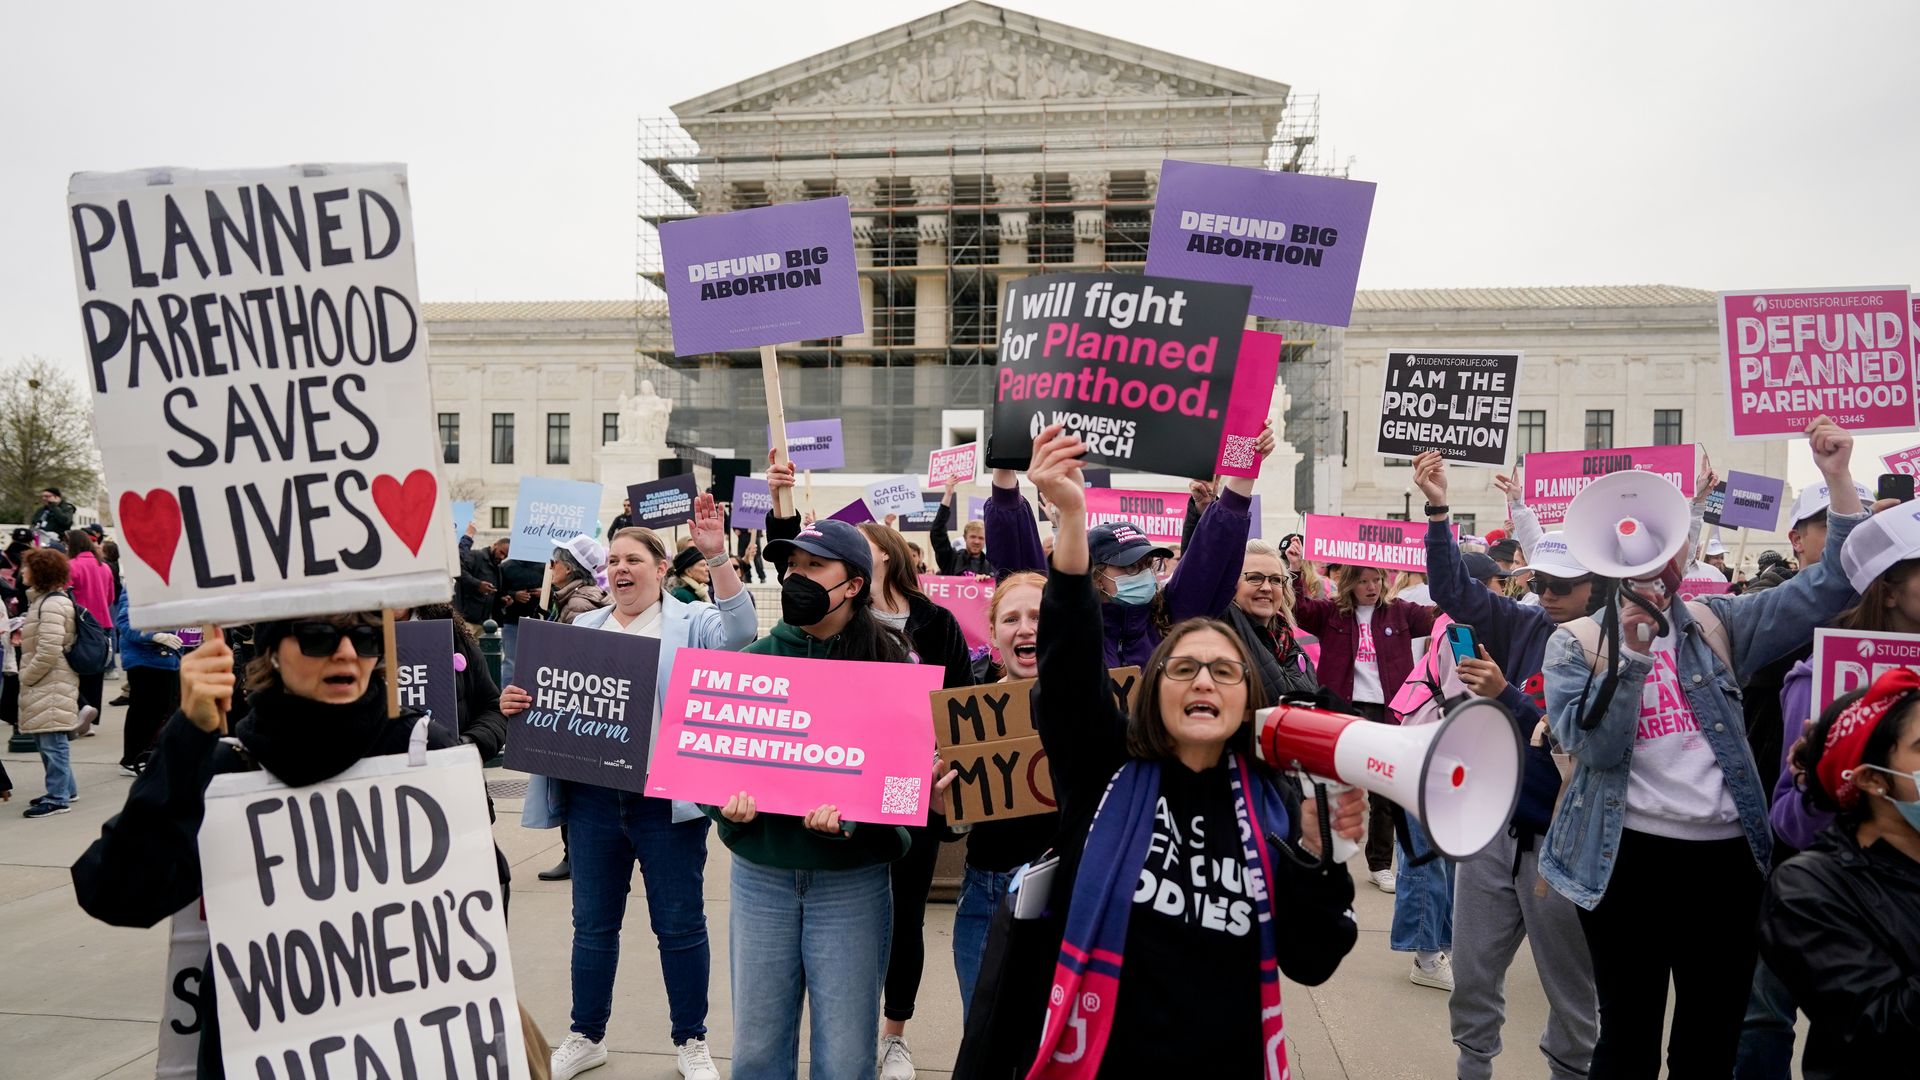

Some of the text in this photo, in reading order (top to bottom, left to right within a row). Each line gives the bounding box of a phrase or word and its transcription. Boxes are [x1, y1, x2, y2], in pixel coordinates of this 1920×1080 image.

[72, 184, 401, 291] PLANNED
[1180, 210, 1338, 247] DEFUND BIG
[688, 246, 829, 283] DEFUND BIG
[1186, 234, 1323, 267] ABORTION
[700, 267, 822, 301] ABORTION
[1006, 282, 1187, 329] I will fight
[1769, 296, 1883, 309] STUDENTSFORLIFE.ORG
[82, 285, 417, 393] PARENTHOOD
[1002, 322, 1218, 373] for Planned
[1737, 312, 1903, 354] DEFUND
[1416, 357, 1498, 367] STUDENTSFORLIFE.ORG
[1739, 351, 1906, 389] PLANNED
[999, 366, 1218, 419] Parenthood.
[1392, 369, 1506, 391] I AM THE
[1383, 391, 1511, 423] PRO-LIFE
[1742, 384, 1908, 414] PARENTHOOD
[163, 374, 379, 468] SAVES
[1052, 411, 1136, 437] WOMEN'S
[1383, 420, 1504, 448] GENERATION
[1787, 417, 1807, 427] TEXT
[1840, 414, 1865, 424] 53445
[932, 449, 975, 467] DEFUND
[1583, 454, 1632, 475] DEFUND
[874, 485, 909, 498] CARE,
[874, 491, 917, 507] NOT CUTS
[1120, 496, 1164, 515] DEFUND
[1733, 489, 1775, 503] DEFUND BIG
[1734, 498, 1771, 510] ABORTION
[530, 502, 586, 517] CHOOSE
[530, 513, 582, 528] HEALTH
[178, 469, 381, 588] LIVES
[523, 523, 546, 536] not
[1359, 524, 1403, 544] DEFUND
[1314, 538, 1366, 560] PLANNED
[955, 585, 979, 599] TO
[536, 666, 631, 700] CHOOSE
[691, 669, 790, 696] I'M FOR
[536, 688, 626, 721] HEALTH
[685, 699, 812, 730] PLANNED
[948, 692, 1010, 744] MY
[526, 704, 630, 743] not harm
[678, 730, 865, 767] PARENTHOOD
[950, 751, 1020, 820] MY
[246, 785, 450, 907] FUND
[217, 889, 497, 1032] WOMEN'S
